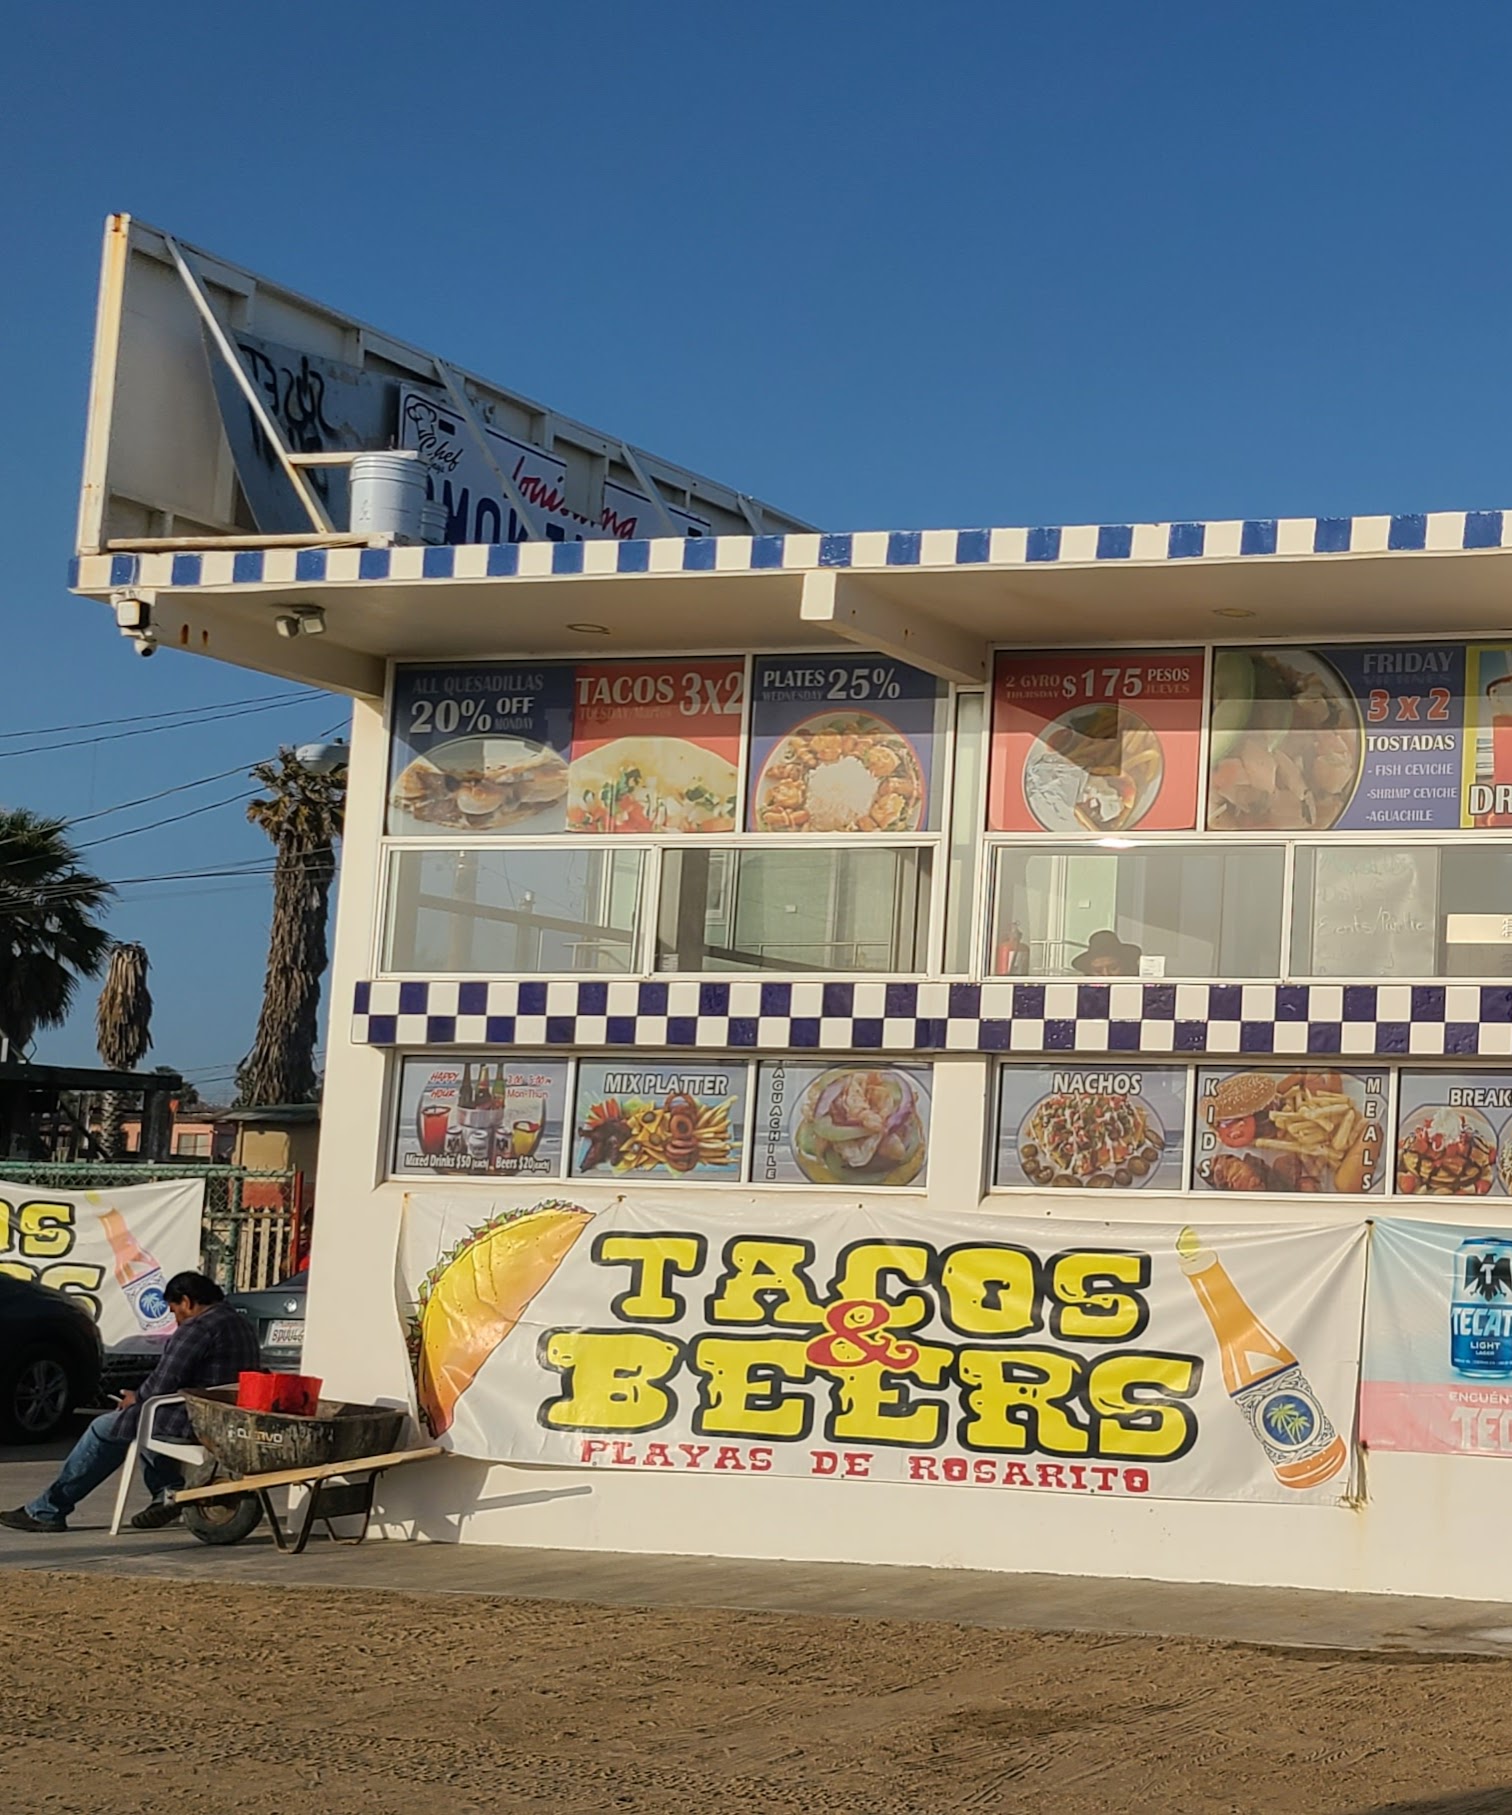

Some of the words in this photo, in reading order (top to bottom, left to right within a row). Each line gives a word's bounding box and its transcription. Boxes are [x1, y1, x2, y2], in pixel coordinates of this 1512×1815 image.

[1363, 652, 1454, 674] FRIDAY
[412, 677, 439, 694] ALL
[444, 673, 544, 694] QUESADILLAS
[576, 676, 674, 704] TACOS
[679, 672, 744, 716] 3x2
[763, 670, 826, 687] PLATES
[827, 668, 900, 699] 25%
[1005, 676, 1015, 688] 2
[1021, 674, 1060, 688] GYRO
[1062, 668, 1143, 698] $175
[1148, 668, 1190, 682] PESOS
[1144, 684, 1190, 694] JUEVES
[762, 690, 824, 701] WEDNESDAY
[1007, 690, 1060, 699] THURSDAY
[1367, 688, 1389, 722] 3
[1395, 697, 1420, 721] x
[1427, 688, 1450, 720] 2
[410, 699, 492, 734] 20%
[496, 697, 535, 715] OFF
[495, 717, 534, 730] MONDAY
[1366, 734, 1455, 752] TOSTADAS
[1375, 764, 1402, 776] FISH
[1405, 763, 1454, 776] CEVICHE
[1413, 787, 1457, 798] CEVICHE
[430, 1072, 459, 1081] HAPPY
[605, 1073, 641, 1094] MIX
[644, 1075, 729, 1095] PLATTER
[1052, 1072, 1142, 1096] NACHOS
[430, 1090, 455, 1098] HOUR
[766, 1066, 786, 1180] AGUACHILE
[1200, 1078, 1219, 1179] KIDS
[1361, 1078, 1381, 1190] MEALS
[405, 1154, 429, 1168] Mixed
[430, 1154, 455, 1168] Drinks
[456, 1155, 471, 1169] $50
[496, 1157, 518, 1170] Beers
[519, 1157, 533, 1171] $20
[1479, 1264, 1495, 1284] T
[592, 1231, 1152, 1343] TACOS
[805, 1300, 918, 1368] &
[1470, 1341, 1501, 1350] LIGHT
[536, 1327, 1204, 1461] BEERS
[580, 1440, 774, 1471] PLAYAS
[812, 1451, 873, 1476] DE
[909, 1459, 1150, 1493] ROSARITO
